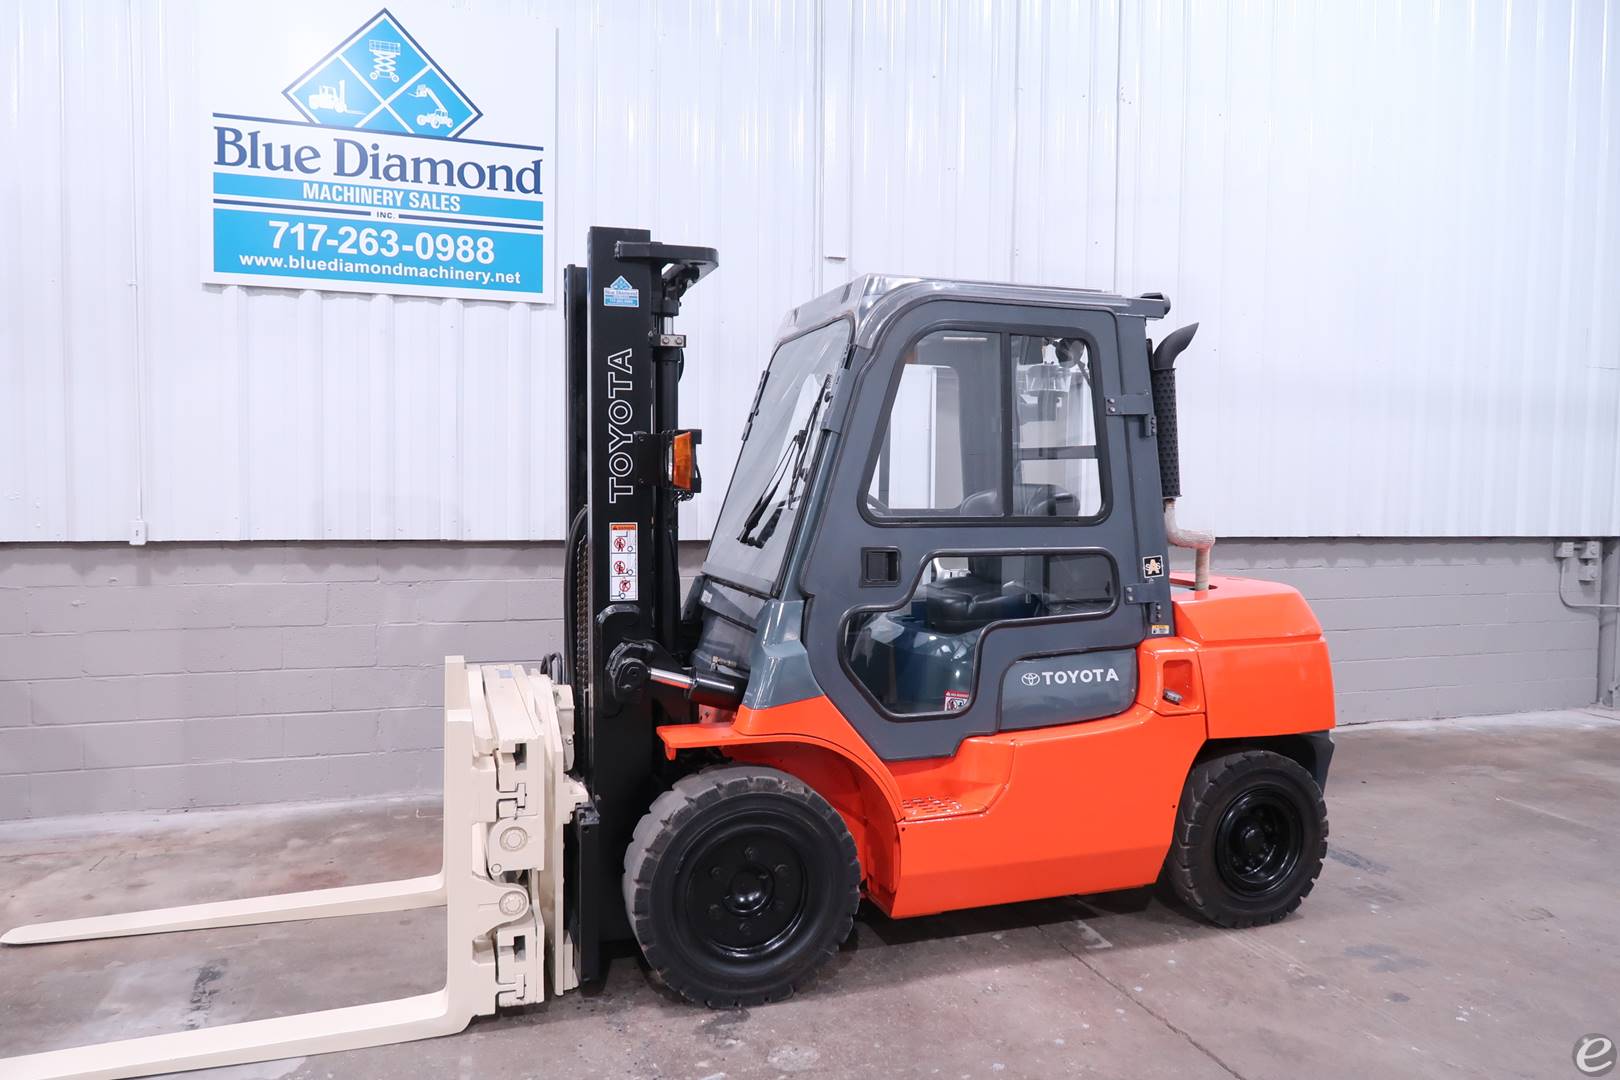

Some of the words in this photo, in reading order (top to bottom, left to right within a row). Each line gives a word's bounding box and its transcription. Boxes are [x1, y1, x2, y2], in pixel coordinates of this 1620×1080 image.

[213, 126, 321, 174] Blue
[333, 138, 543, 195] Diamond
[302, 182, 405, 208] MACHINERY
[408, 191, 461, 212] SALES
[376, 211, 396, 220] INC.
[268, 220, 495, 265] 717-263-0988
[239, 254, 521, 285] www.bluediamondmachinery.net
[608, 348, 634, 504] TOYOTA
[1042, 668, 1119, 685] TOYOTA
